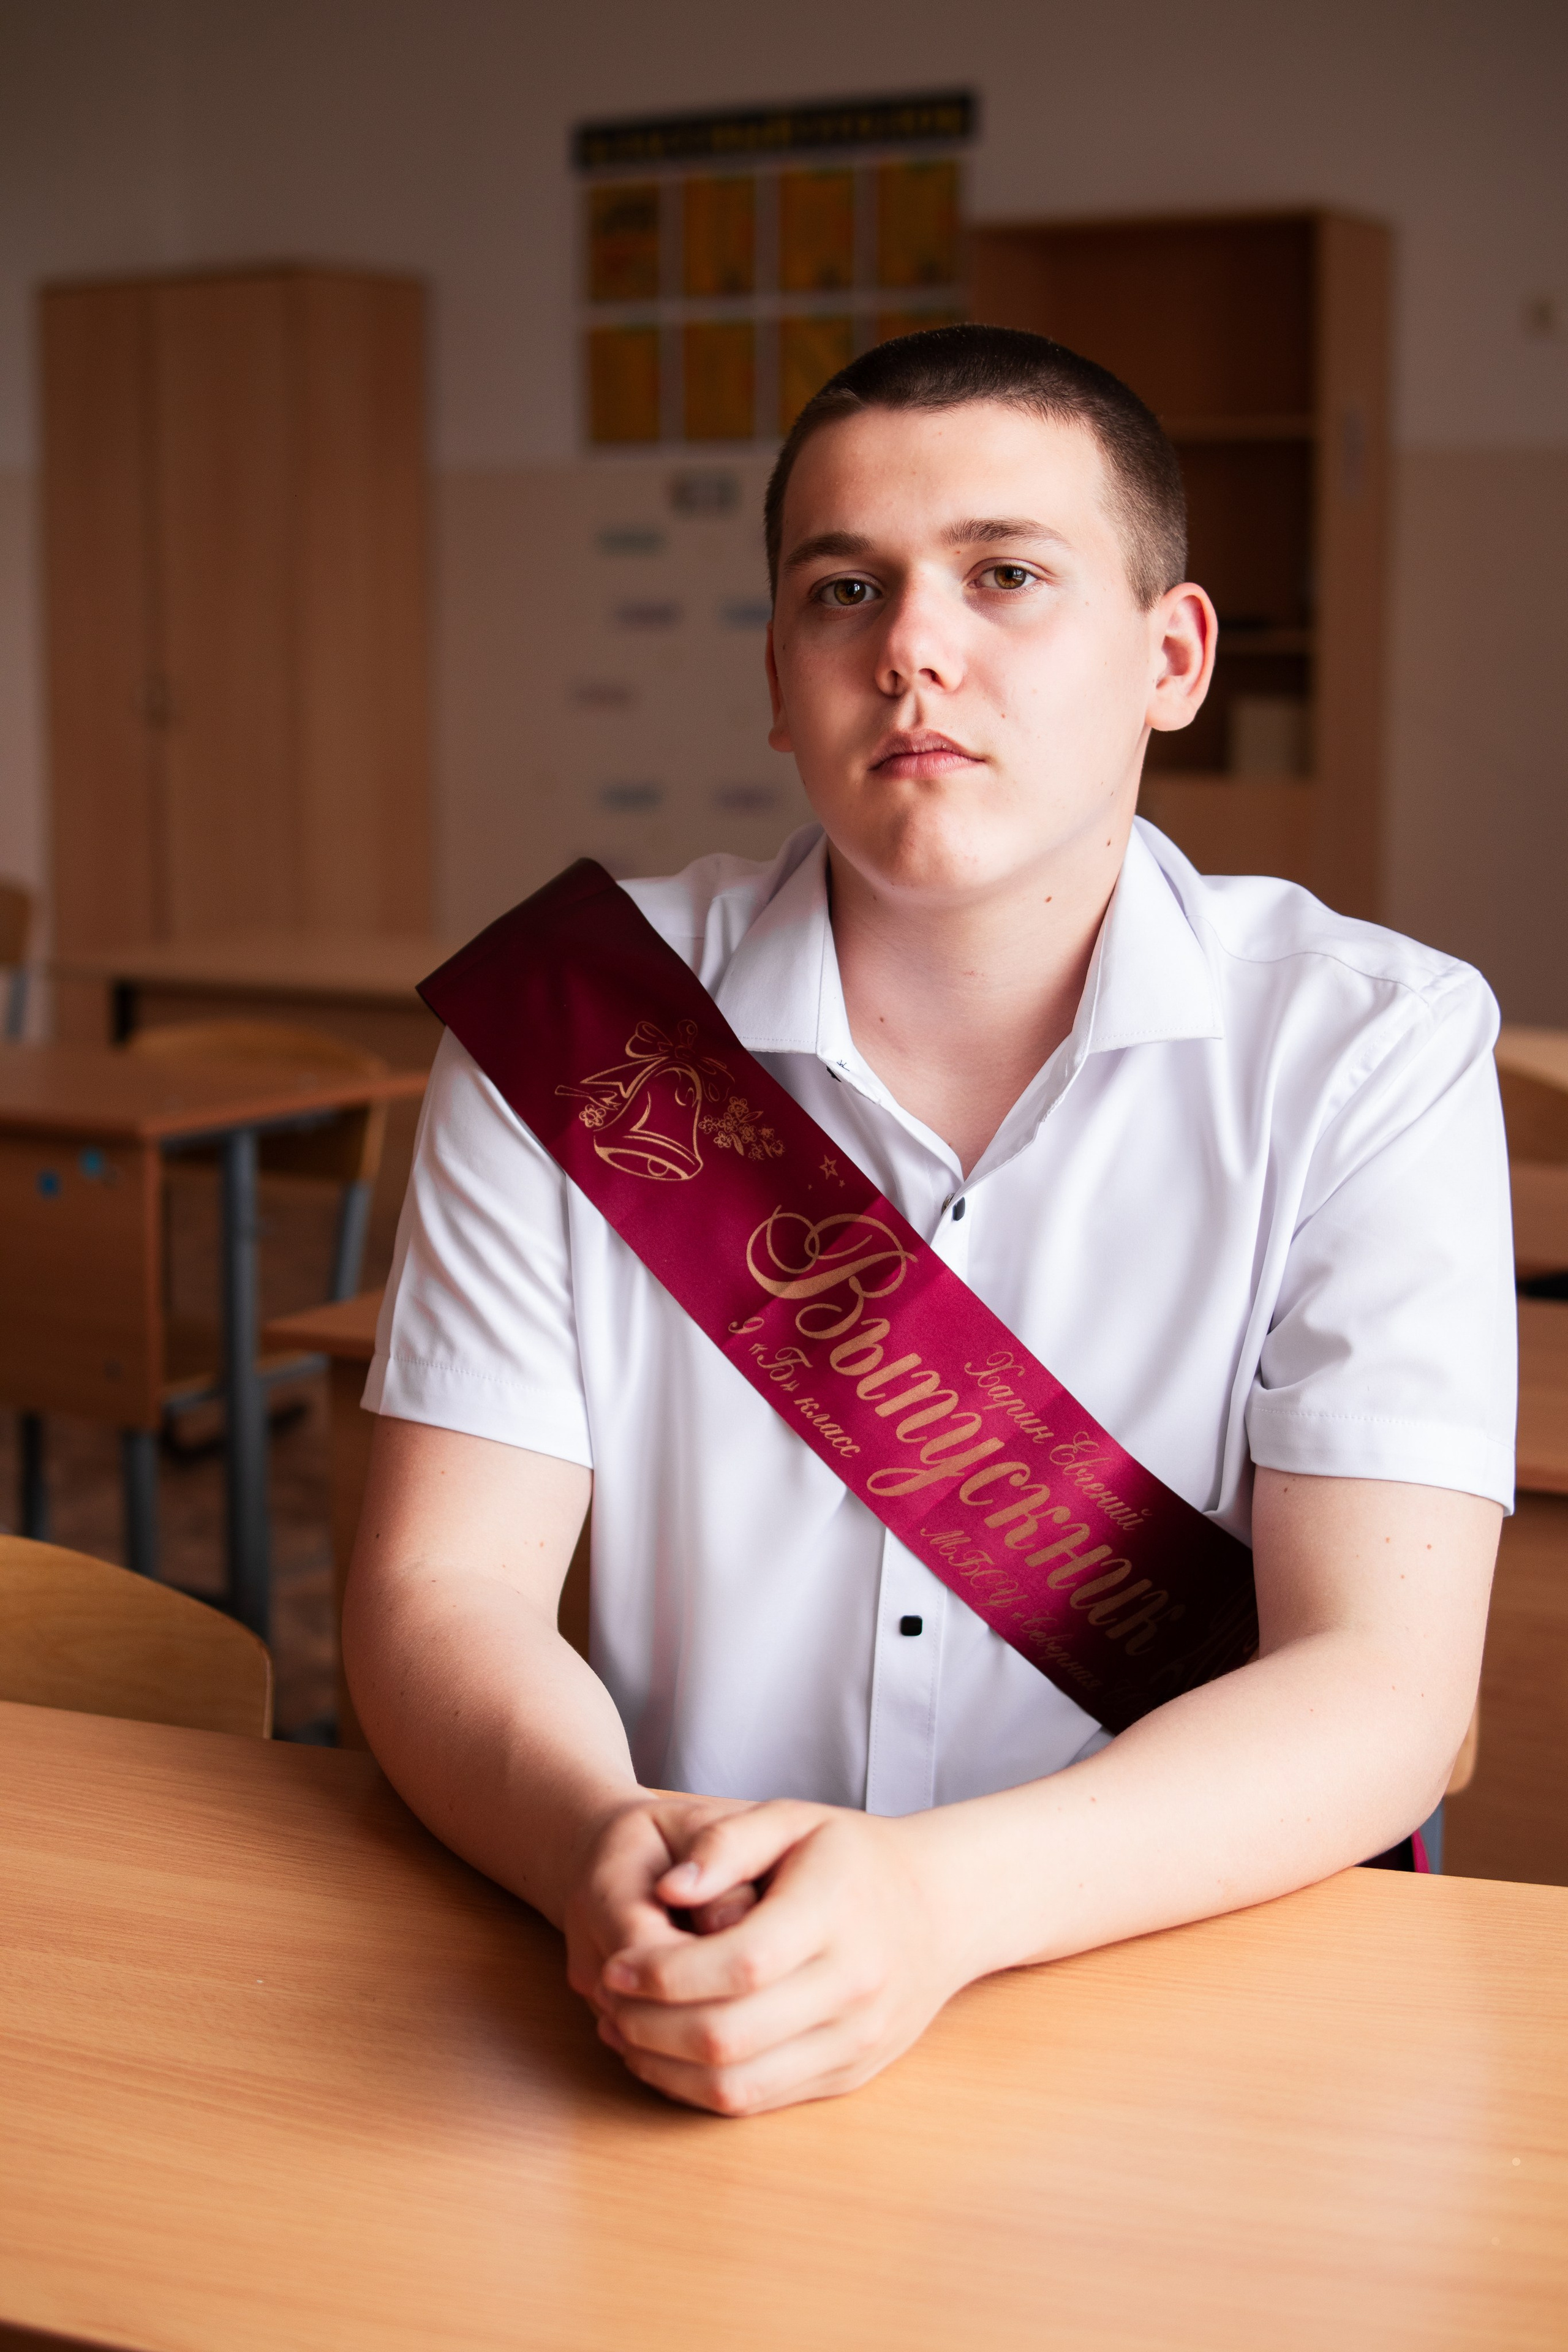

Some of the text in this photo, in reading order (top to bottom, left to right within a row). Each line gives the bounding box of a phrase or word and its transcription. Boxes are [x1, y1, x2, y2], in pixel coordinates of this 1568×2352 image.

[728, 1317, 764, 1335] 9
[793, 1397, 861, 1458] класс
[745, 1204, 1186, 1657] Выпускник
[964, 1351, 1153, 1531] Харин Евгений
